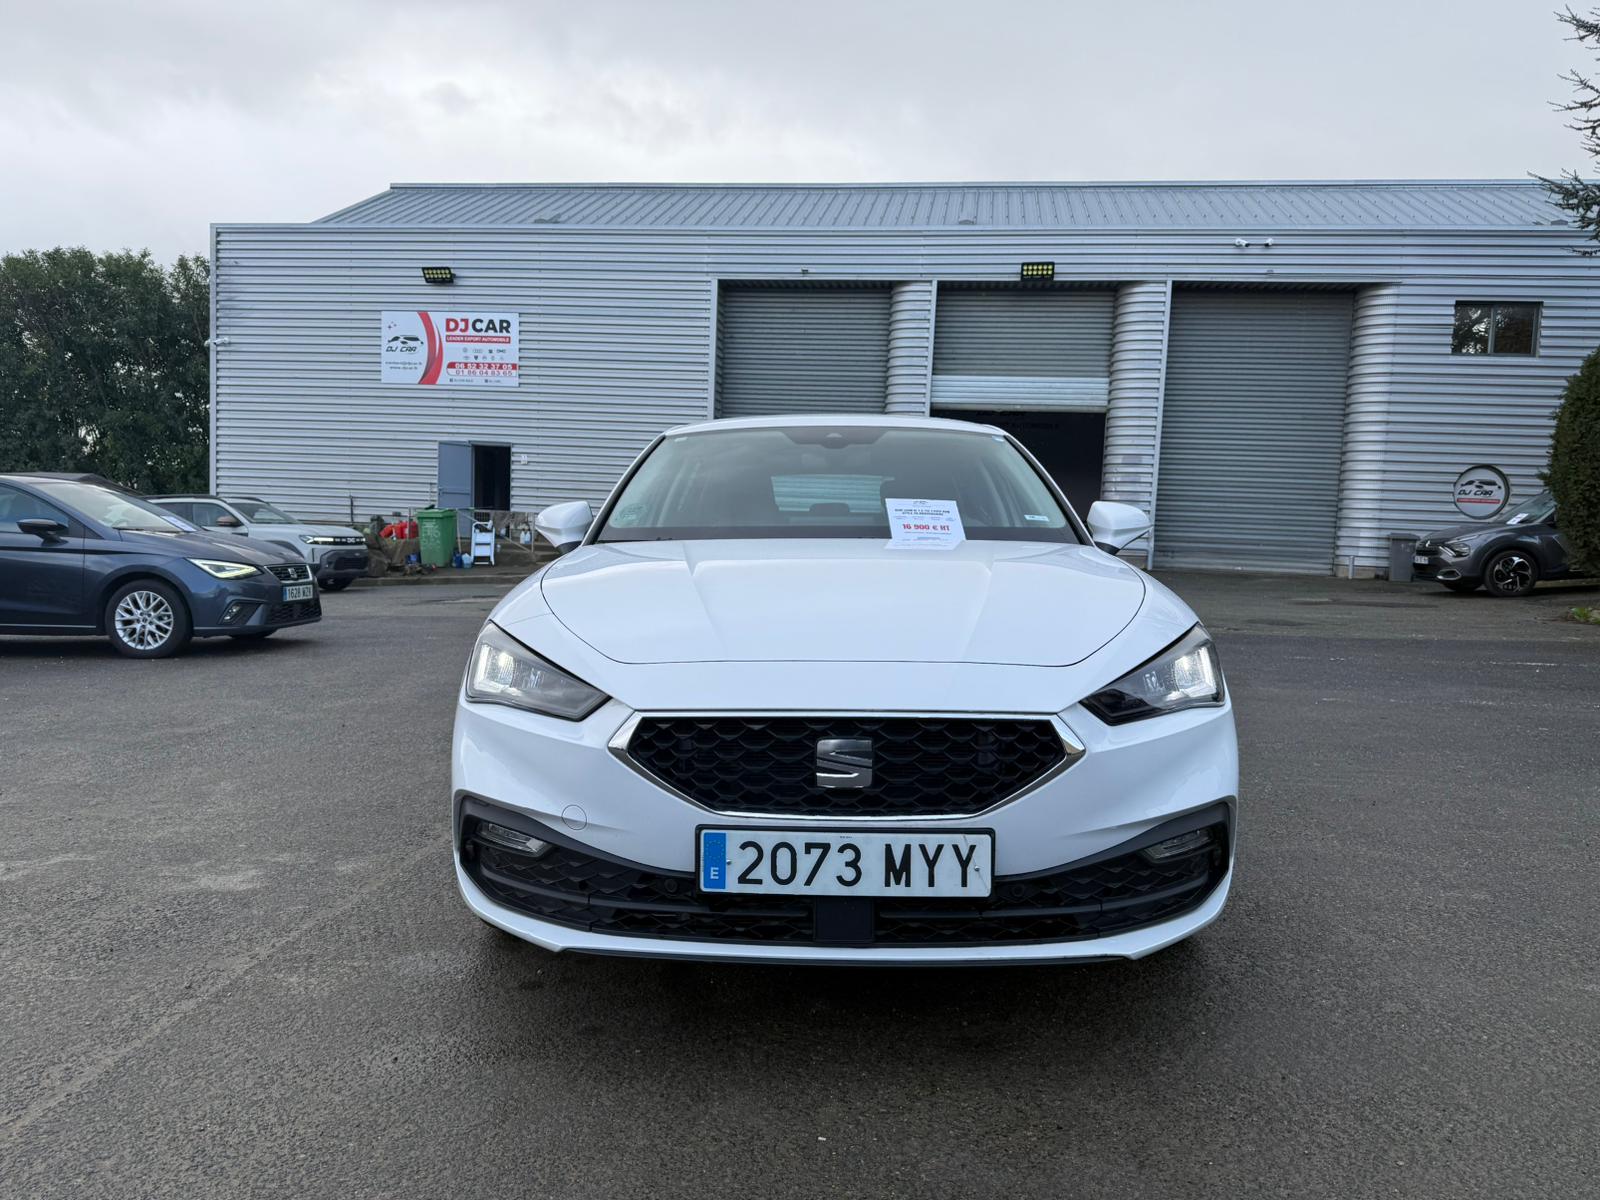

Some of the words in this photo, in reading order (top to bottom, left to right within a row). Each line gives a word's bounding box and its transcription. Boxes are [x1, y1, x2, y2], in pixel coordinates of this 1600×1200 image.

[710, 868, 719, 879] E
[738, 841, 863, 887] 2073
[884, 843, 977, 888] MYY
